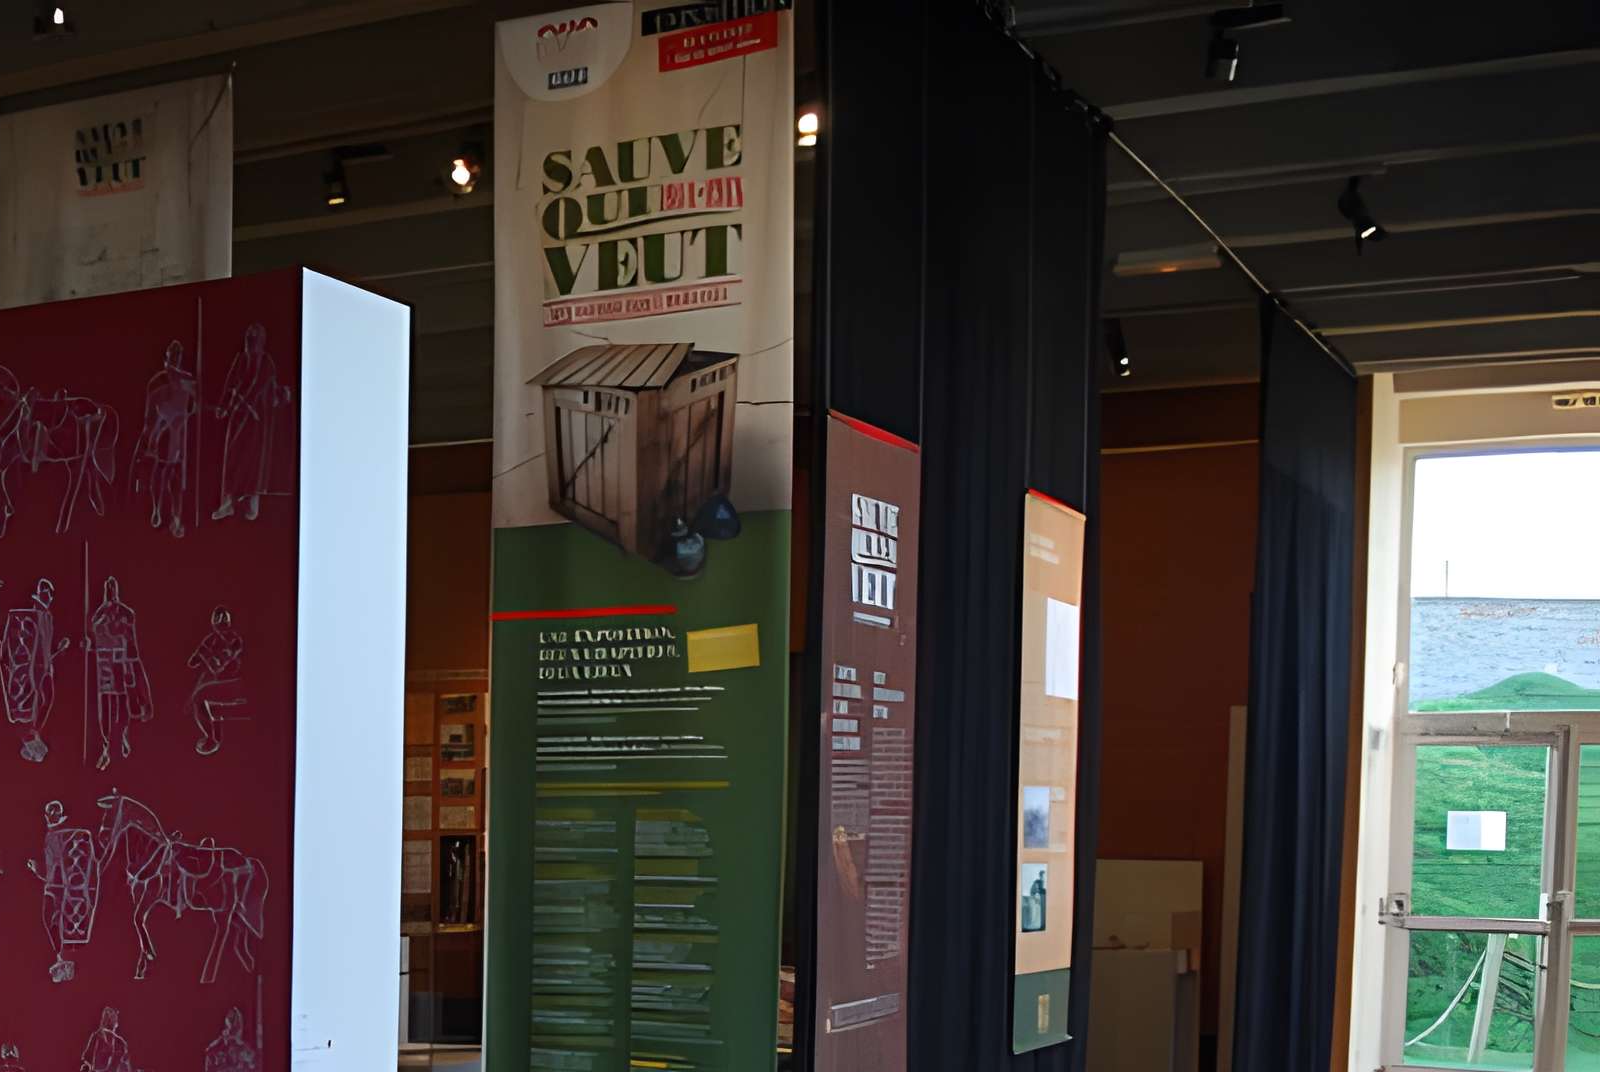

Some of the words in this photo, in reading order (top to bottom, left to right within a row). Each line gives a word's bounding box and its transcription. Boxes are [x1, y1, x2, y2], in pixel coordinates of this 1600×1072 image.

[542, 124, 742, 195] SAUVE
[542, 184, 664, 241] QUI
[544, 224, 743, 297] VEUT
